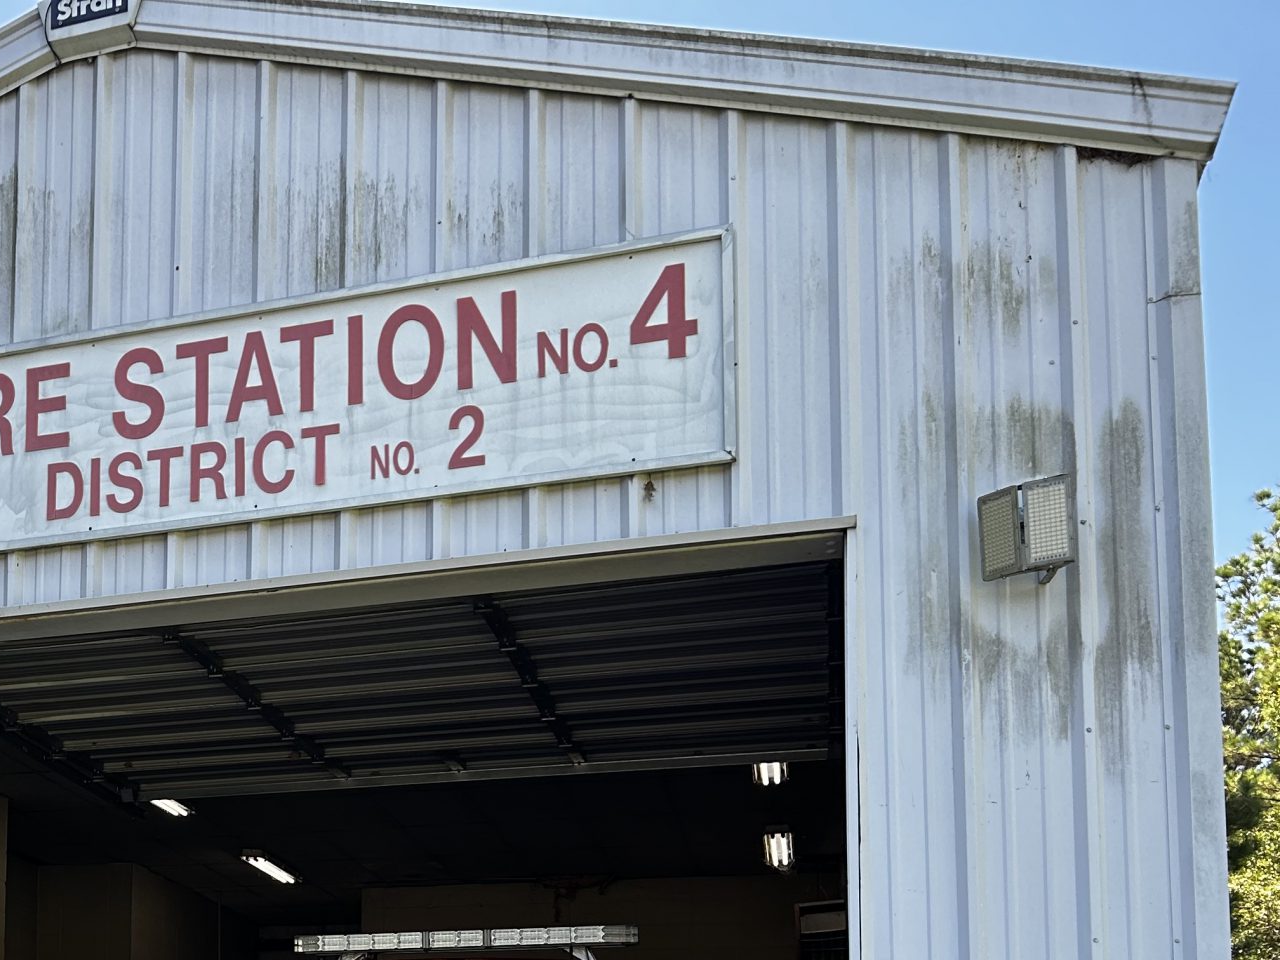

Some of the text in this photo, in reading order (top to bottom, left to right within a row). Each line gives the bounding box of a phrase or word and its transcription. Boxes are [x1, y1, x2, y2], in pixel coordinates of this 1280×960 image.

[112, 290, 518, 440] STATION
[537, 323, 619, 378] NO.
[630, 263, 698, 359] 4
[46, 405, 485, 521] DISTRICT NO. 2
